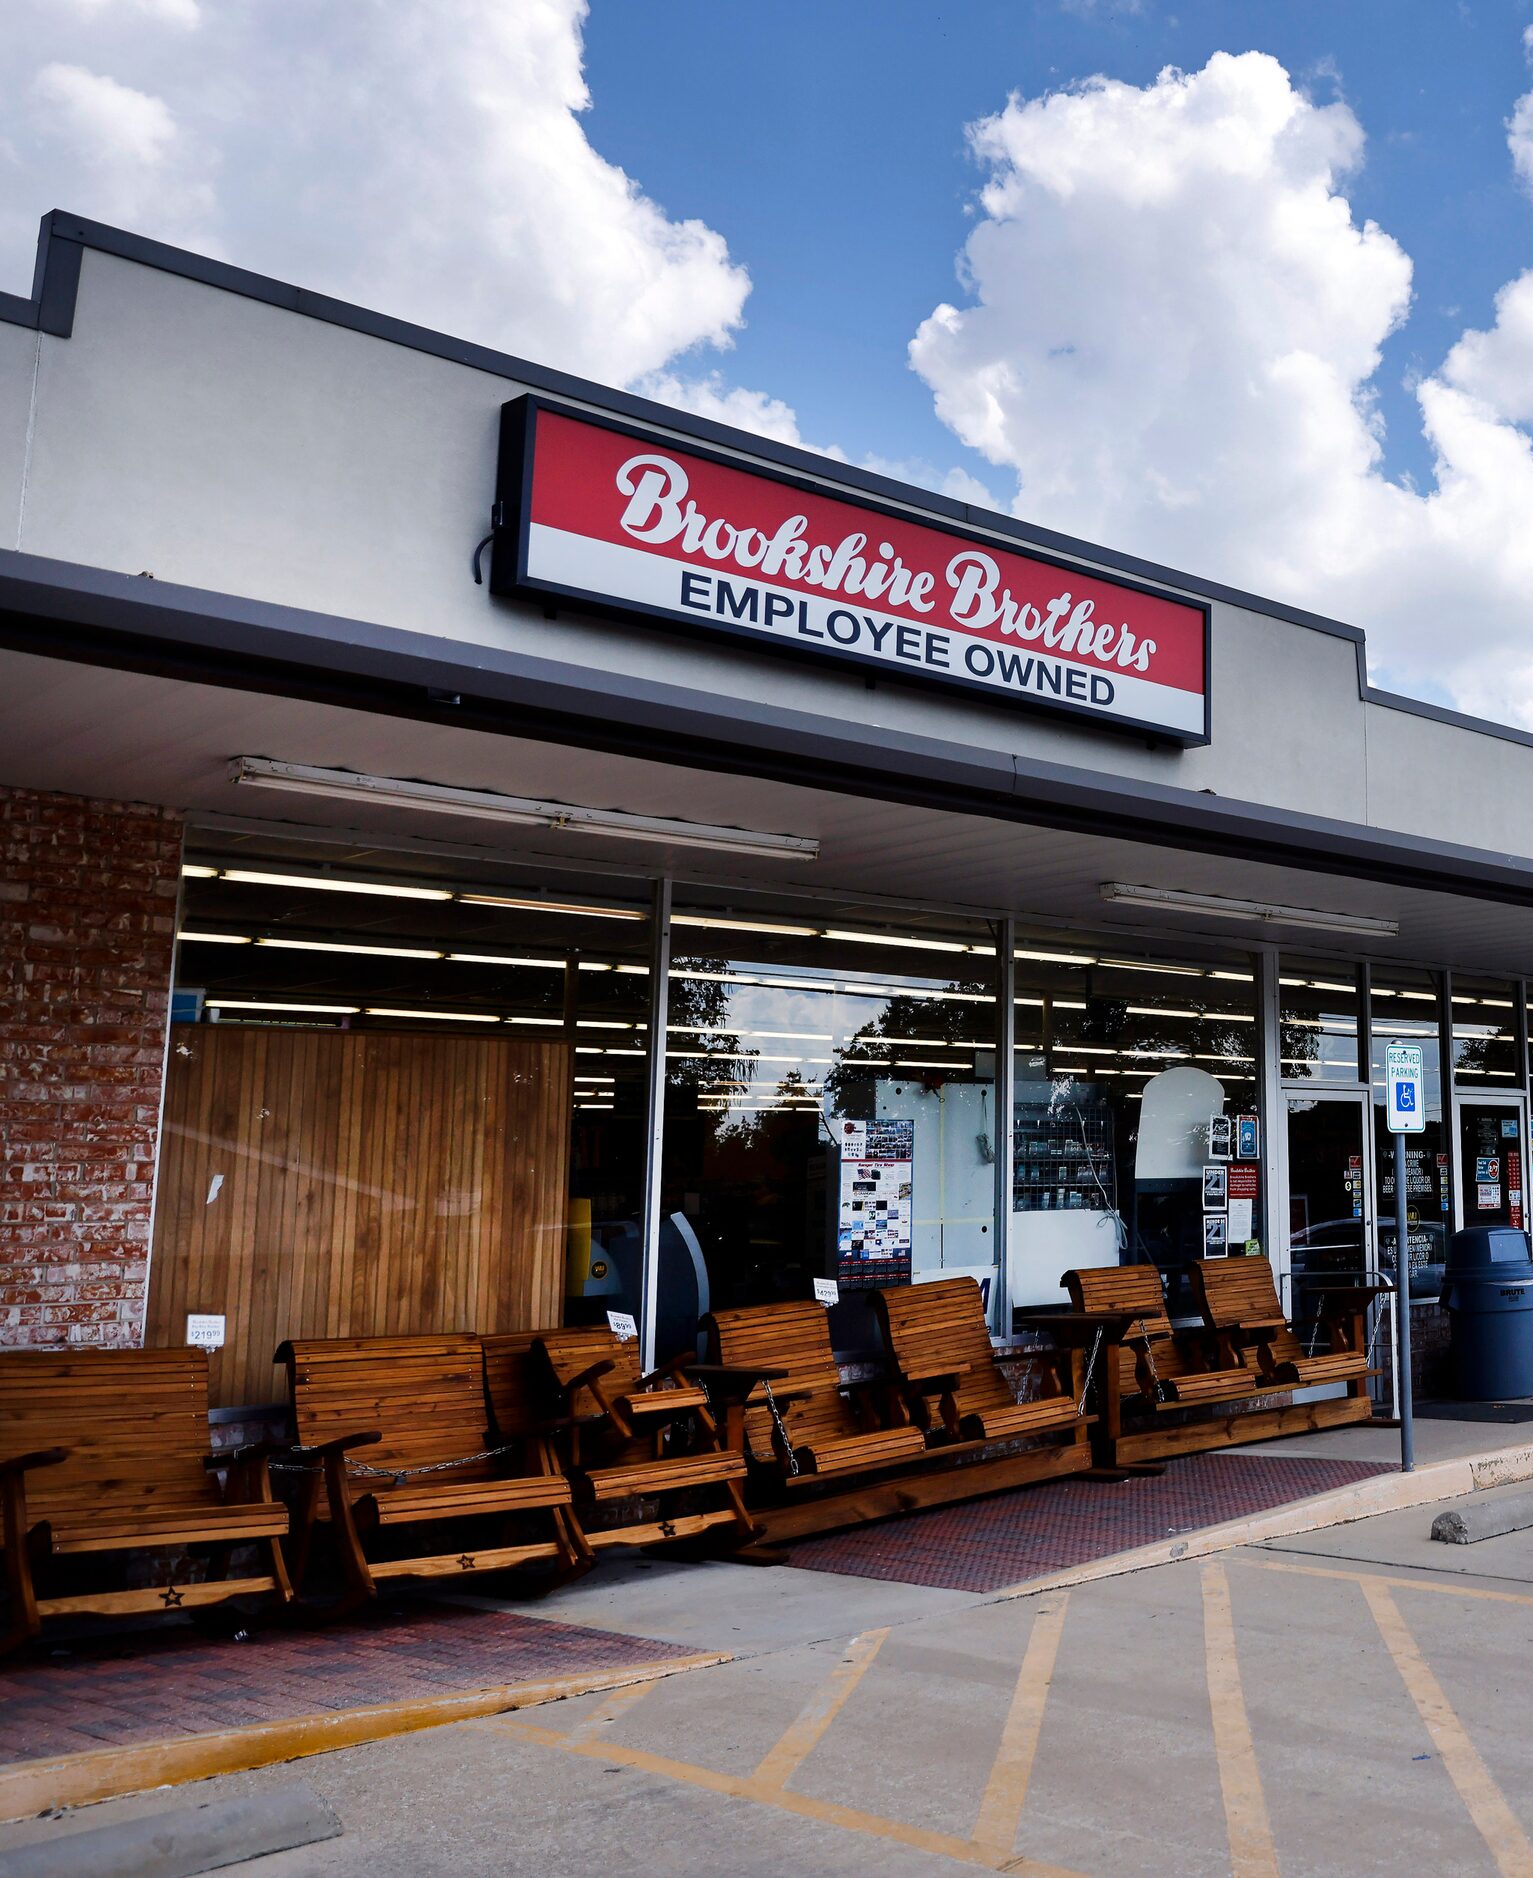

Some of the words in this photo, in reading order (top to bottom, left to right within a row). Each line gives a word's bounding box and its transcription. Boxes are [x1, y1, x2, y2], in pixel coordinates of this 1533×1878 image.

[616, 454, 935, 613] Brookshire
[946, 551, 1156, 672] Brothers
[681, 571, 950, 668] EMPLOYEE
[964, 644, 1115, 706] OWNED
[1389, 1053, 1419, 1064] RESERVED
[1391, 1067, 1418, 1078] PARKING
[1205, 1174, 1225, 1190] 21
[1410, 1176, 1424, 1184] LIQUOR
[1383, 1185, 1394, 1193] BEER
[1206, 1223, 1225, 1240] 21
[1500, 1288, 1525, 1297] BRUTE
